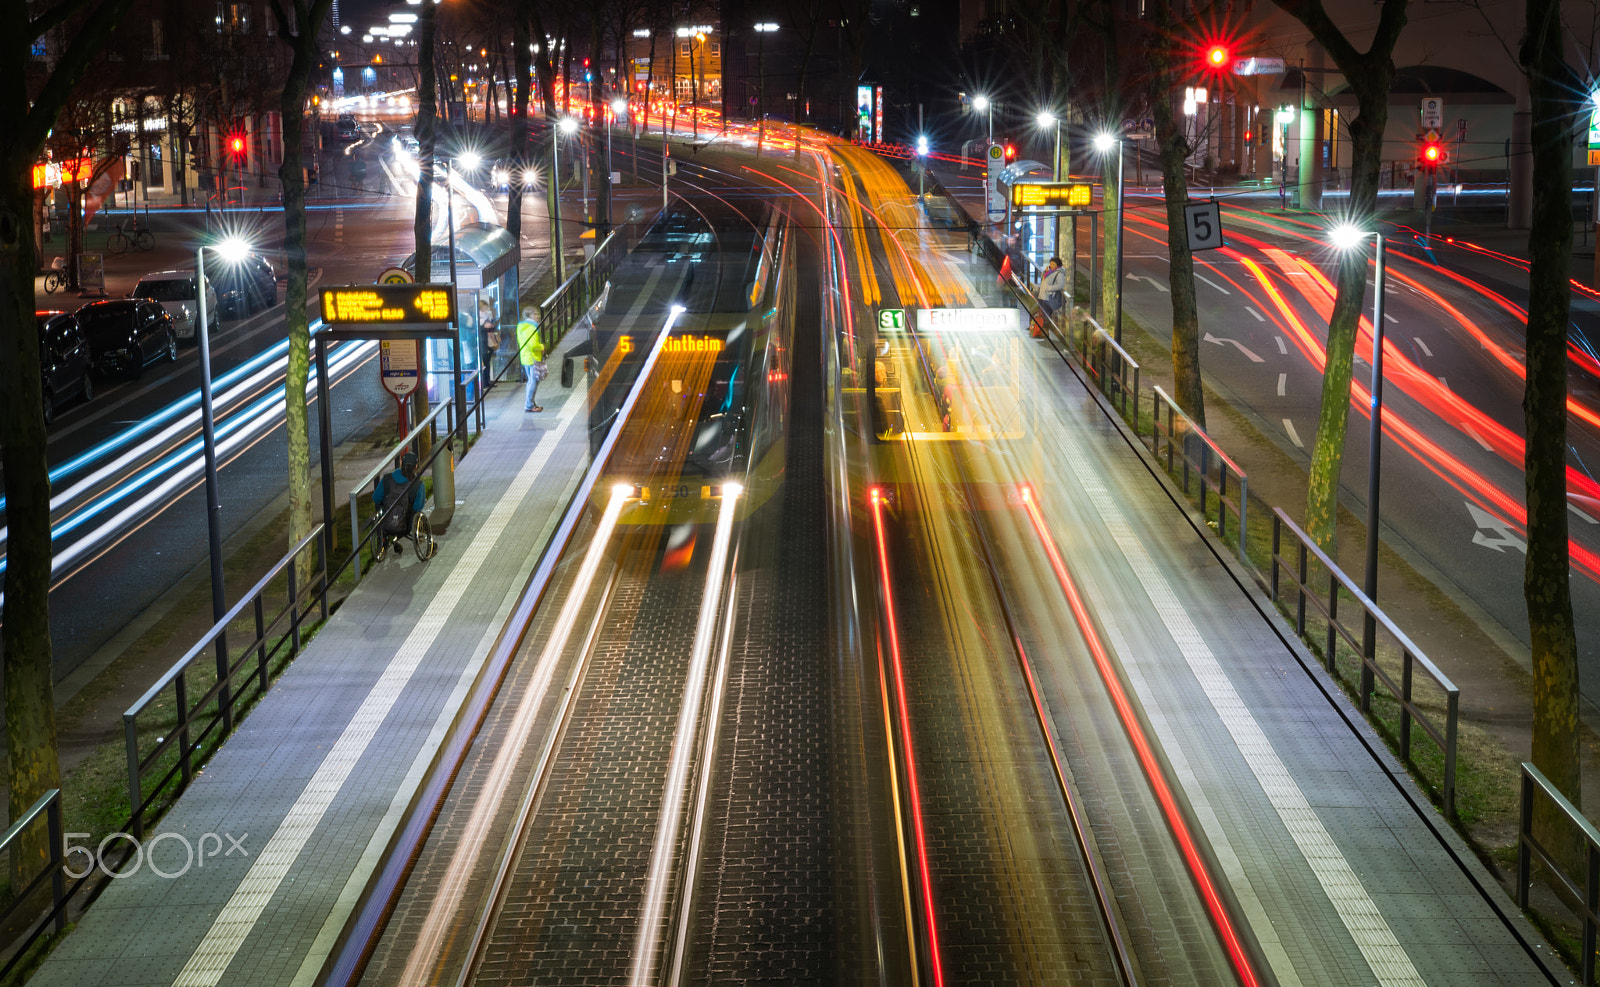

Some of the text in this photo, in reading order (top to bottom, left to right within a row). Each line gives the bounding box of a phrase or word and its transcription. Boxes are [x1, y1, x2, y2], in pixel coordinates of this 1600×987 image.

[1193, 211, 1212, 241] 5
[881, 310, 904, 329] S1
[930, 309, 1007, 328] Ettlingen
[620, 335, 631, 353] 5
